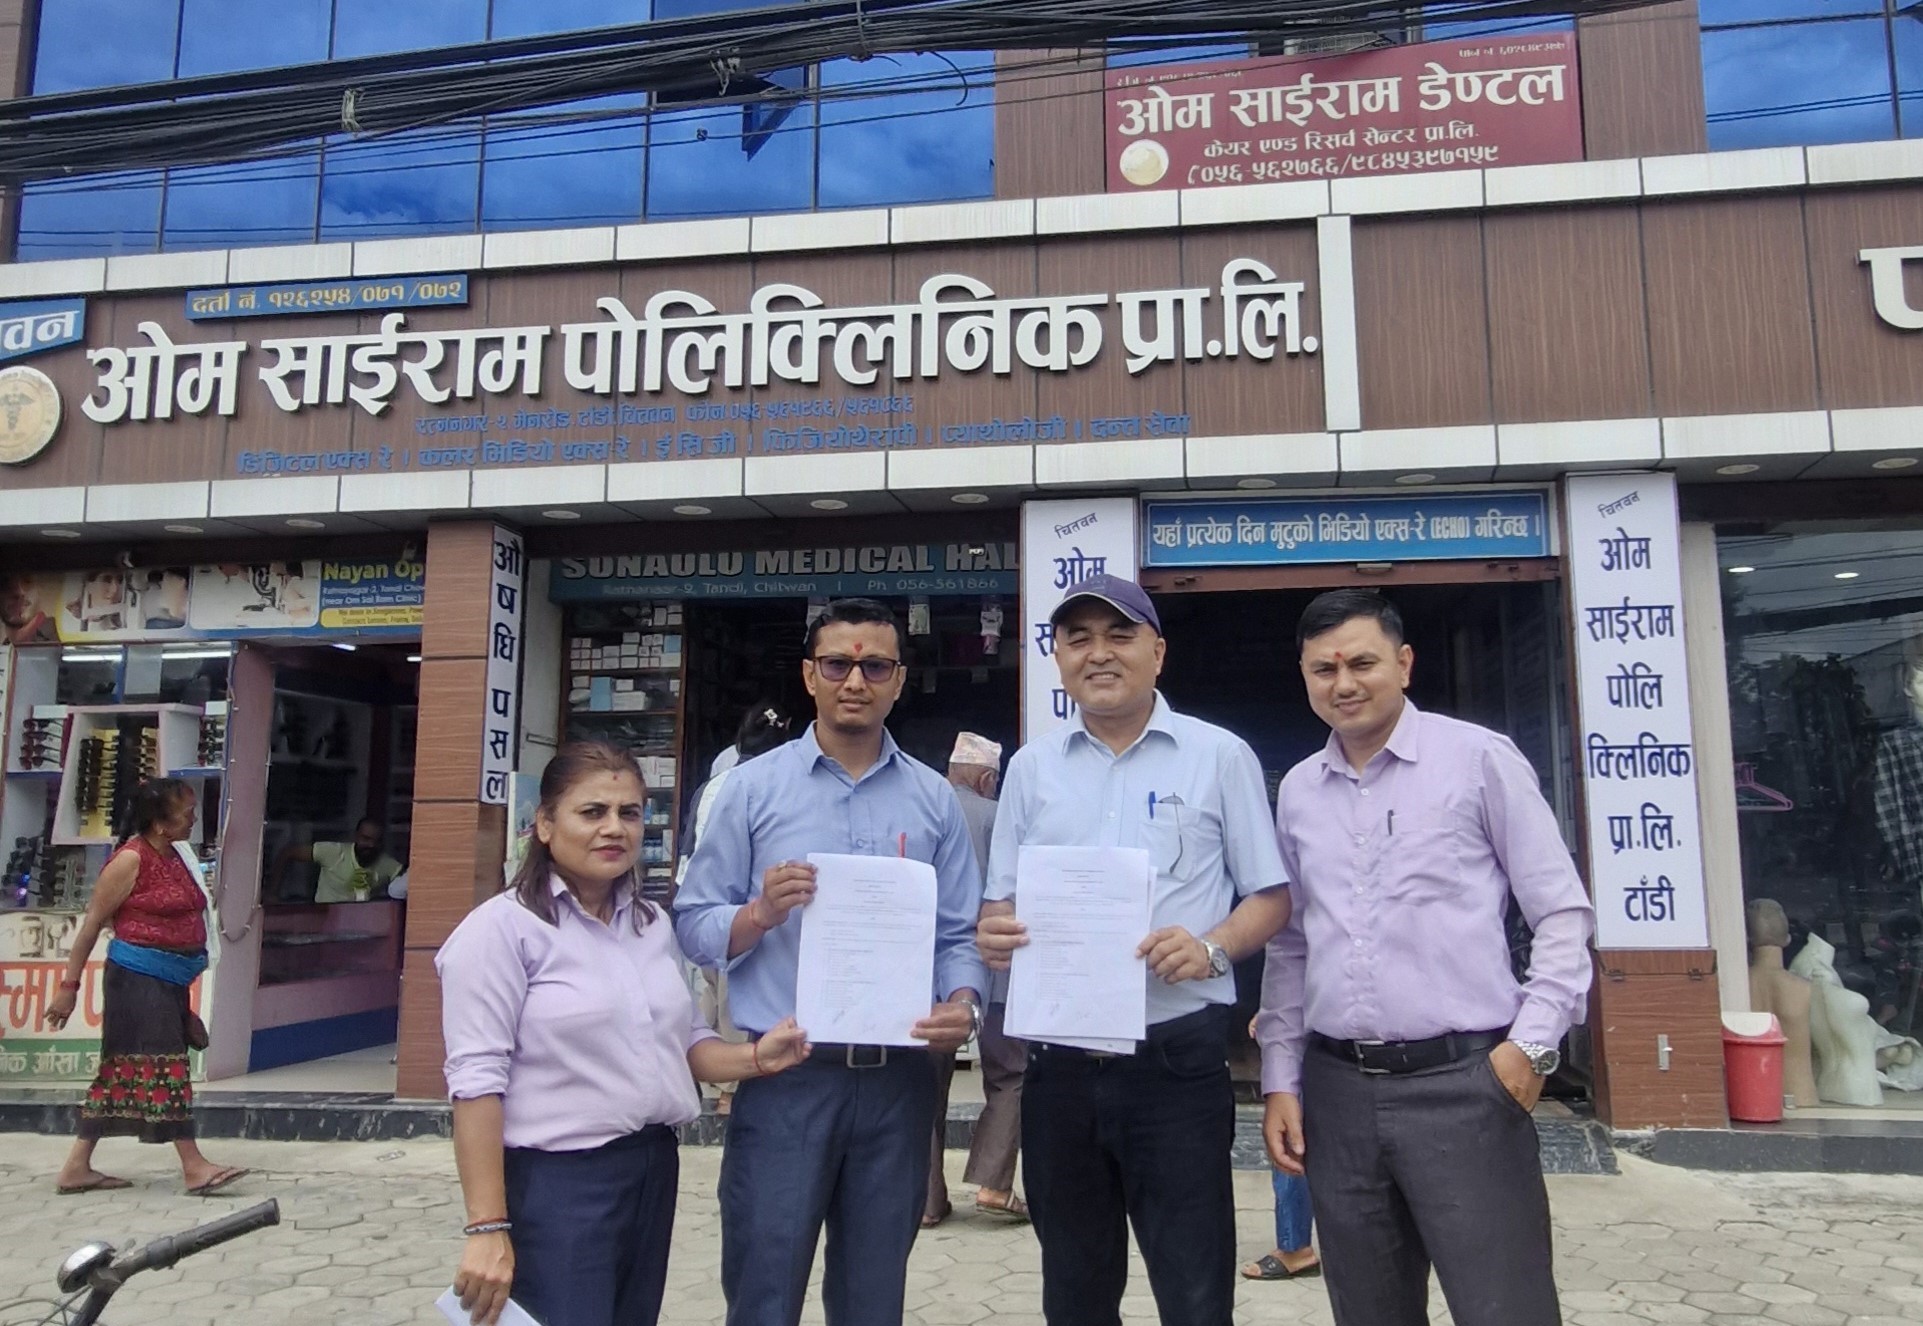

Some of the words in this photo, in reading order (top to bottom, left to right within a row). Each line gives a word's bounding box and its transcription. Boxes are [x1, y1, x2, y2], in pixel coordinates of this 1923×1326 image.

[1117, 86, 1212, 136] ओम
[1229, 73, 1402, 128] साईराम
[1419, 62, 1567, 111] डेण्टल
[1204, 139, 1252, 158] केयर
[1260, 137, 1298, 153] एण्ड
[1362, 126, 1417, 147] सेन्टर
[0, 311, 80, 350] वन
[82, 321, 248, 423] ओम
[259, 313, 551, 416] साईराम
[562, 274, 1108, 394] पोलिक्लिनिक
[1117, 258, 1319, 375] प्रा.लि.
[1054, 512, 1099, 540] चितवन
[1597, 490, 1641, 518] चितवन
[1153, 517, 1182, 548] यहाँ
[1186, 517, 1233, 549] प्रत्येक
[1237, 514, 1265, 546] दिन
[1270, 514, 1315, 550] मुटुको
[1318, 512, 1371, 543] भिडियो
[1475, 508, 1530, 539] गरिन्छ
[1599, 527, 1652, 572] ओम
[323, 562, 389, 584] Nayan
[394, 560, 424, 582] Op
[562, 551, 743, 580] SUNAULO
[755, 544, 935, 576] MEDICAL
[945, 542, 1019, 572] HAL
[1585, 596, 1676, 644] साईराम
[1606, 661, 1664, 710] पोलि
[1587, 732, 1691, 780] क्लिनिक
[1607, 802, 1682, 854] प्रा.लि.
[1623, 875, 1675, 921] टाँडी
